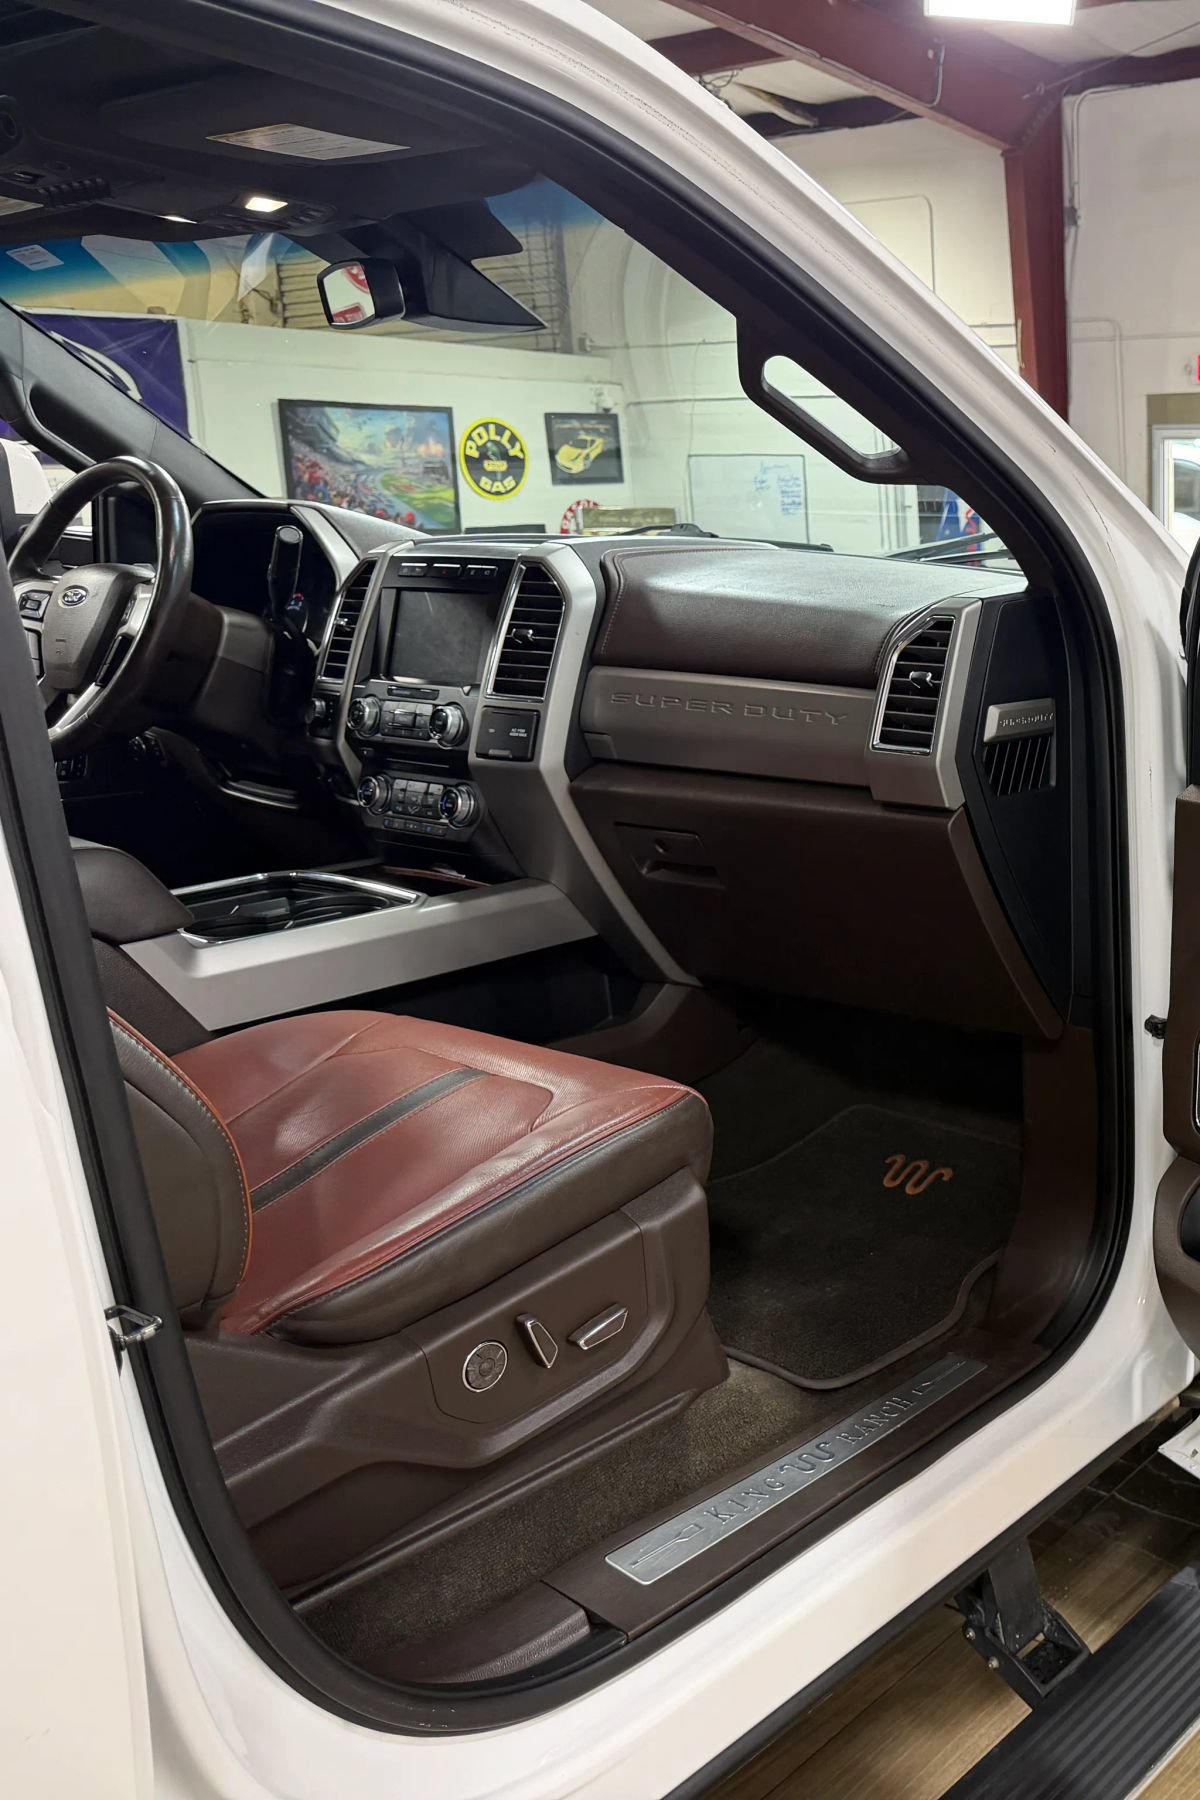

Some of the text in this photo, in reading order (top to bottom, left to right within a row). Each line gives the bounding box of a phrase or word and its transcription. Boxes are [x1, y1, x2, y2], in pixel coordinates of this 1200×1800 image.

[465, 423, 525, 459] POLLY
[479, 475, 516, 493] GAS
[610, 692, 848, 726] SUPER DUTY
[703, 1396, 914, 1525] KING RANCH
